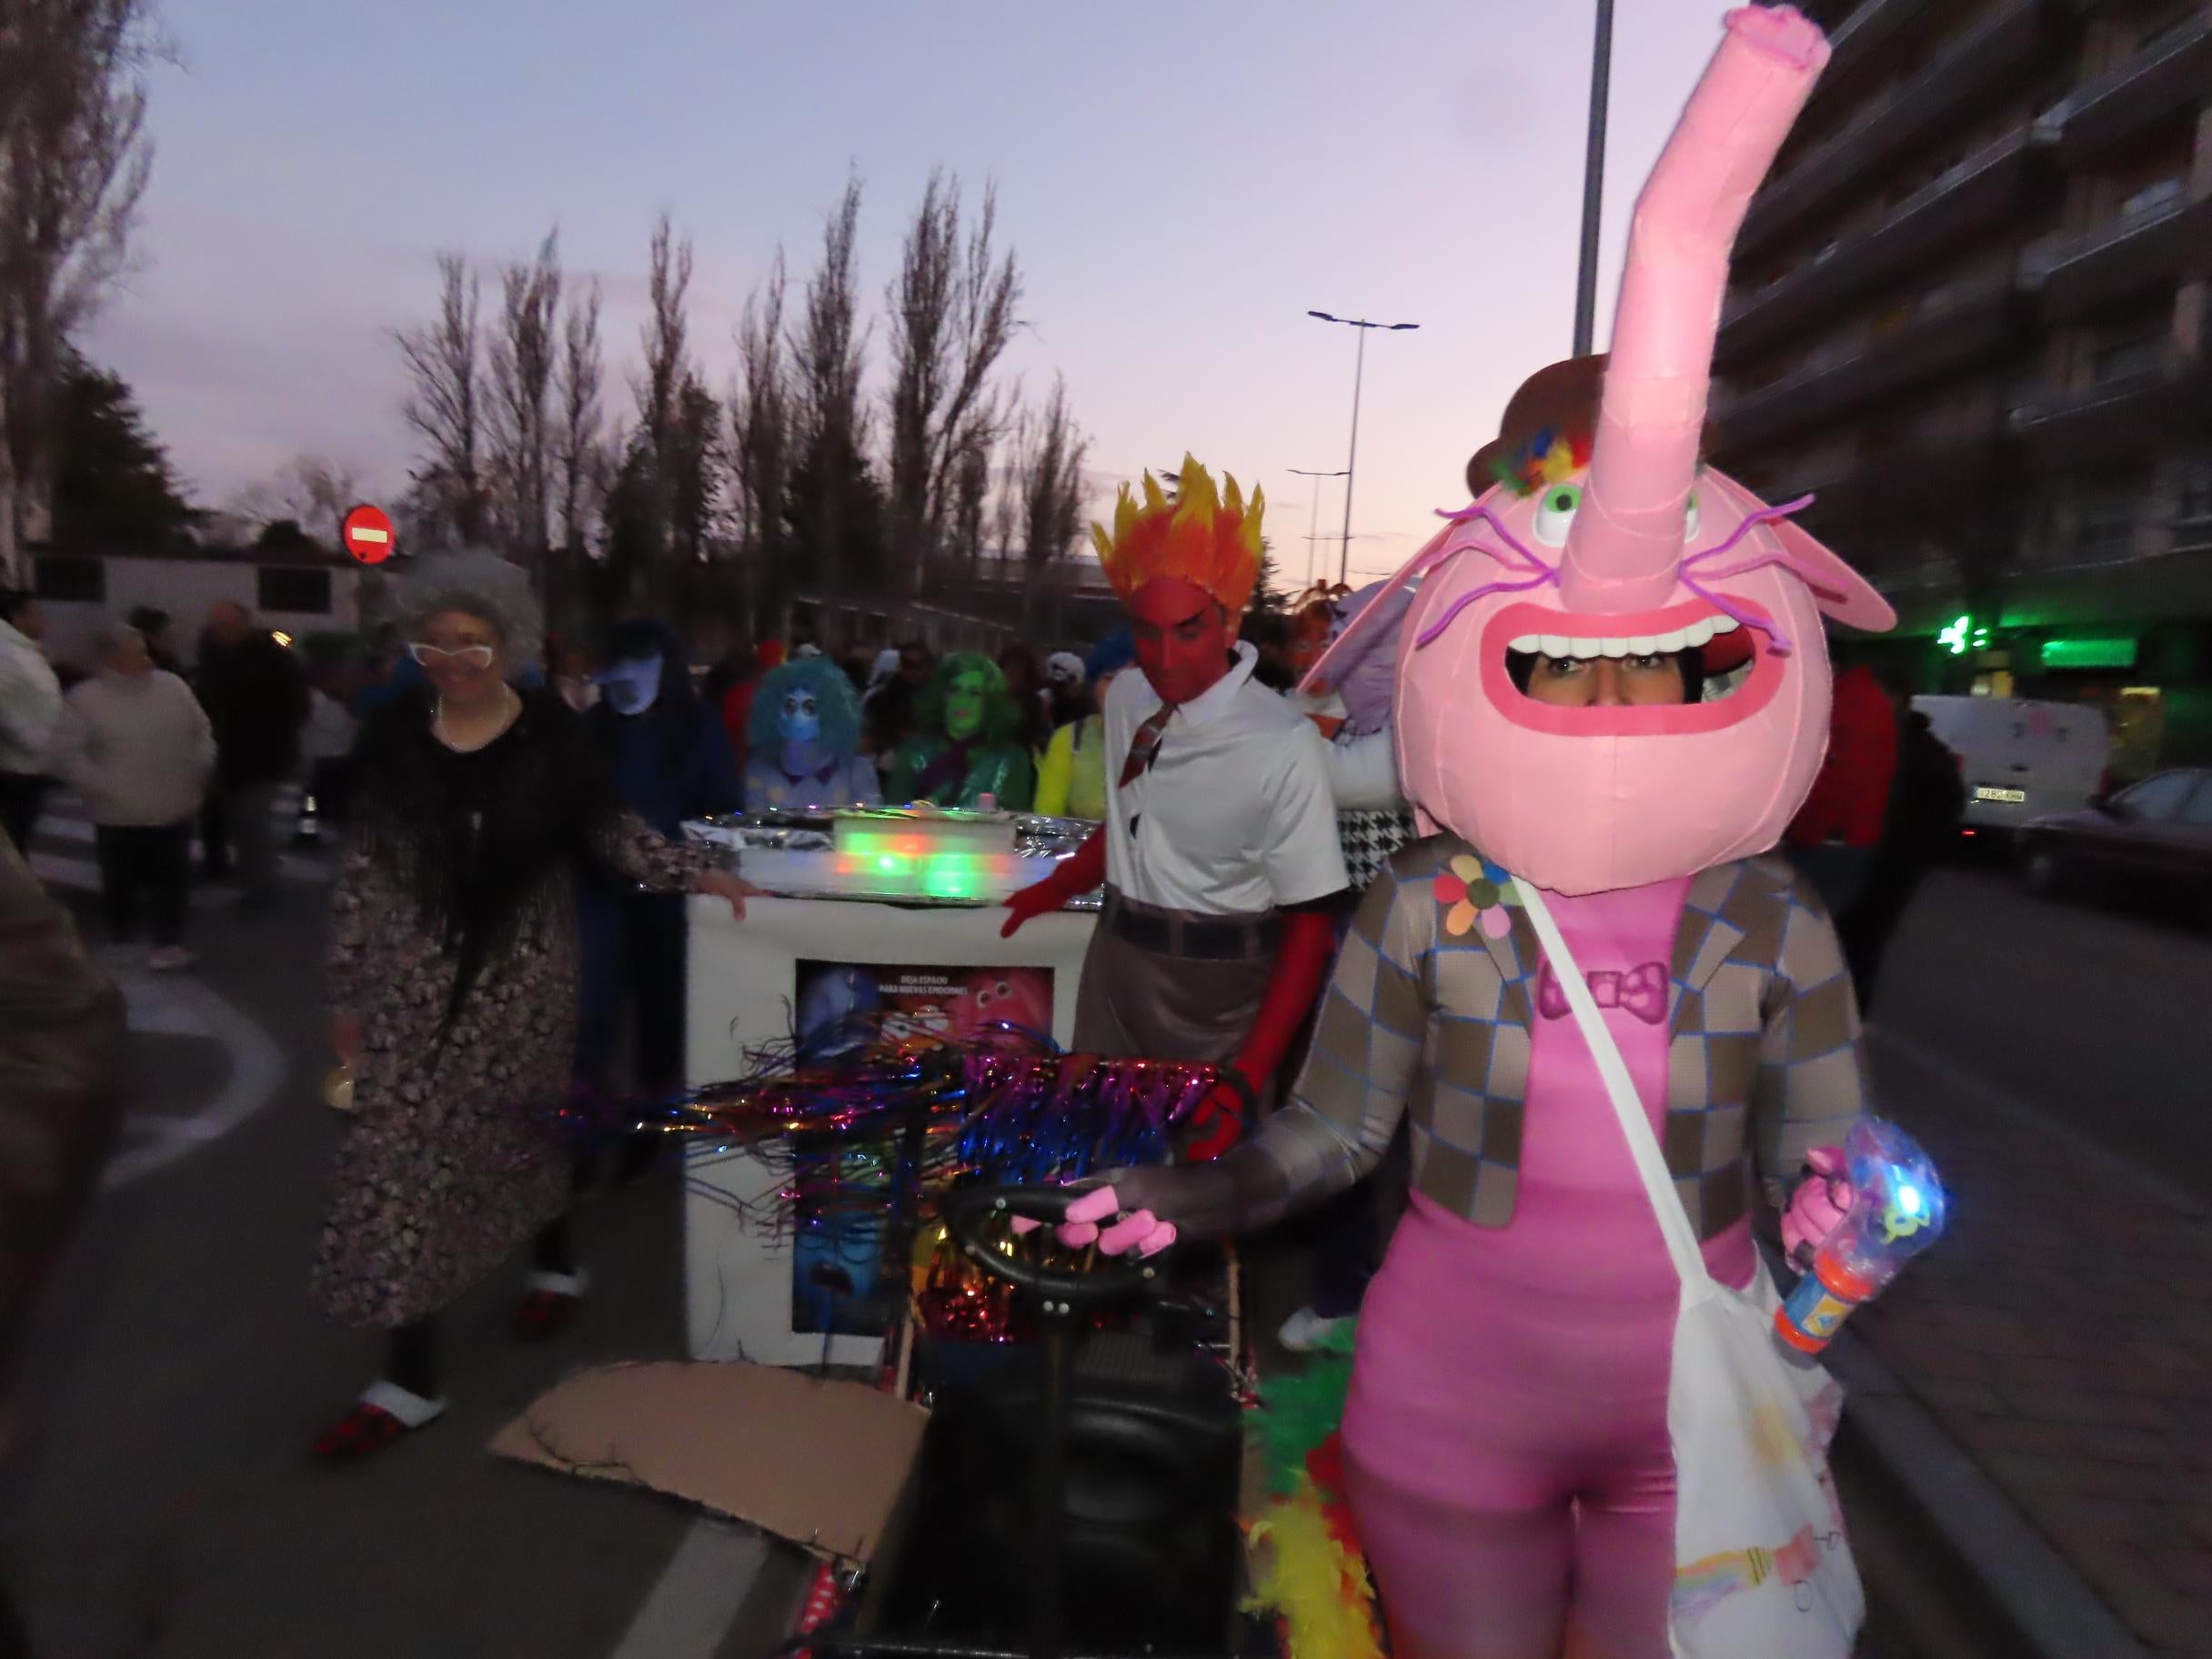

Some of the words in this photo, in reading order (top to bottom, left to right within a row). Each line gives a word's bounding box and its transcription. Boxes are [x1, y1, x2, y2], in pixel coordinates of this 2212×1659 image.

[901, 975, 918, 984] DEJA
[919, 975, 948, 985] ESPACIO
[879, 984, 898, 993] PARA
[900, 985, 927, 994] NUEVAS
[928, 986, 968, 995] EMOCIONES
